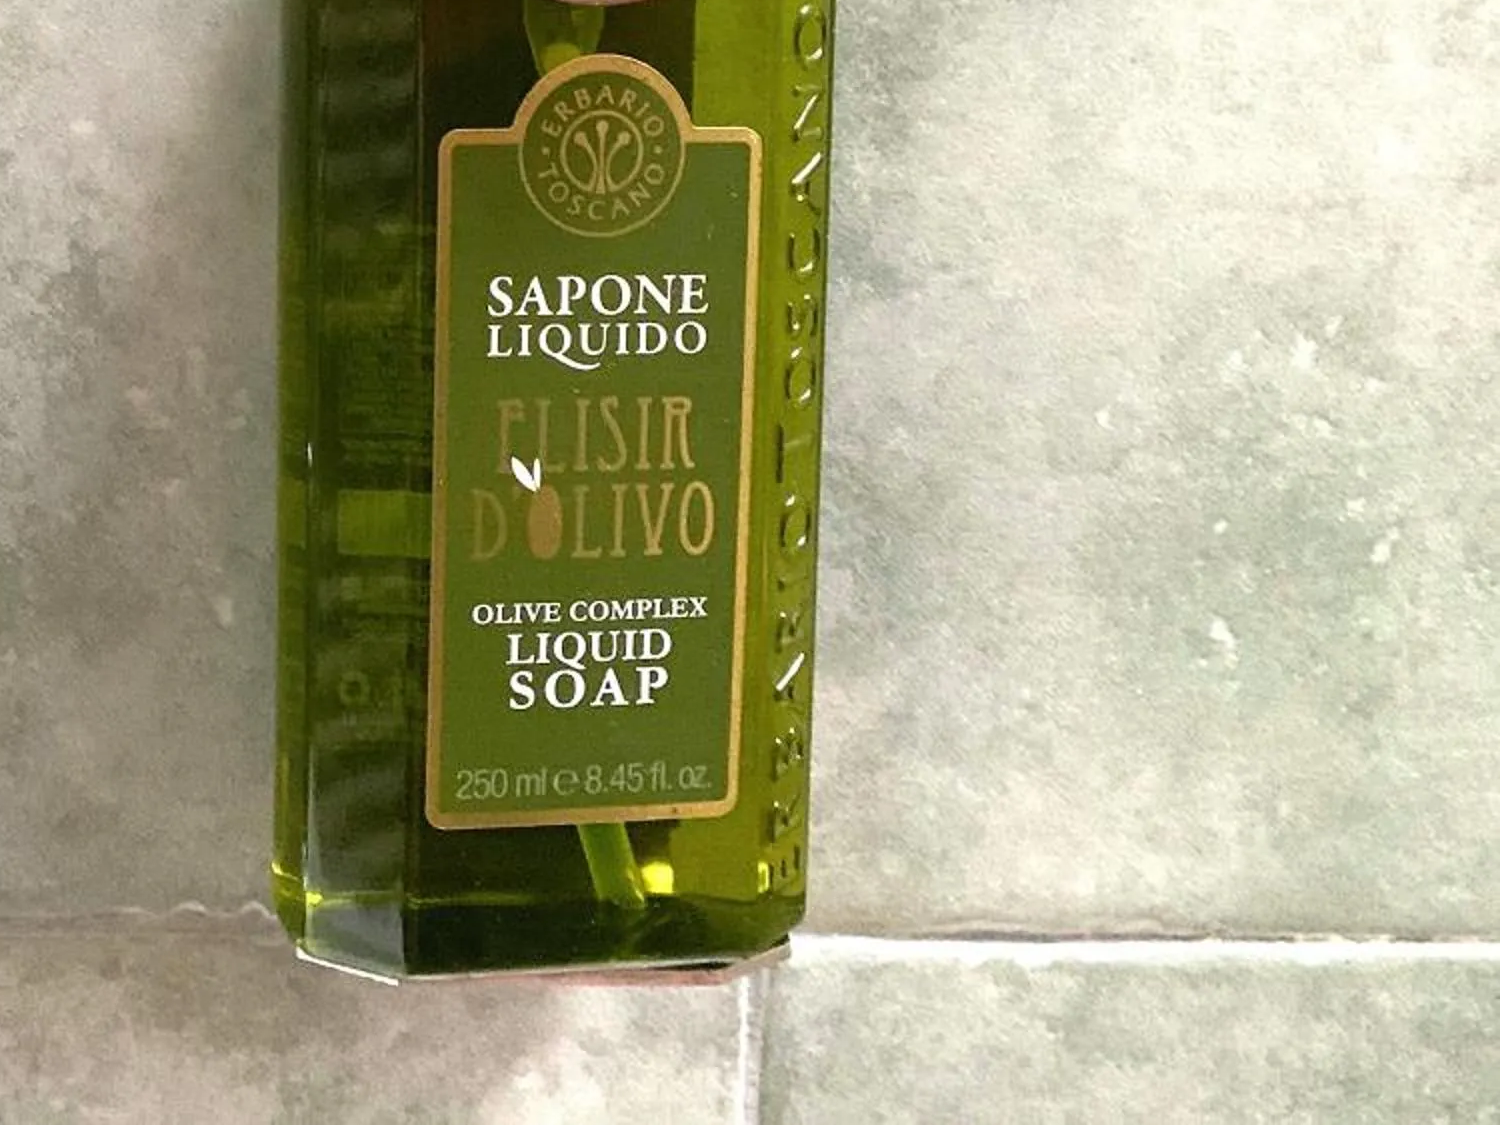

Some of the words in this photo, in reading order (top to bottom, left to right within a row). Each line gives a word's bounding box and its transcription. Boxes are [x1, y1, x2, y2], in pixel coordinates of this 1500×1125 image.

[541, 83, 665, 137] ERBARIO
[537, 160, 665, 222] TOSCANO
[487, 274, 709, 317] SAPONE
[487, 321, 708, 370] LIQUIDO
[495, 395, 696, 474] ELISIR
[472, 601, 561, 625] OLIVE
[569, 596, 708, 623] COMPLEX
[506, 628, 672, 670] LIQUID
[509, 666, 669, 710] SOAP
[455, 767, 509, 800] 250
[515, 766, 548, 797] ml
[584, 762, 645, 794] 8.45
[649, 760, 673, 792] fl.
[678, 765, 713, 791] oz.
